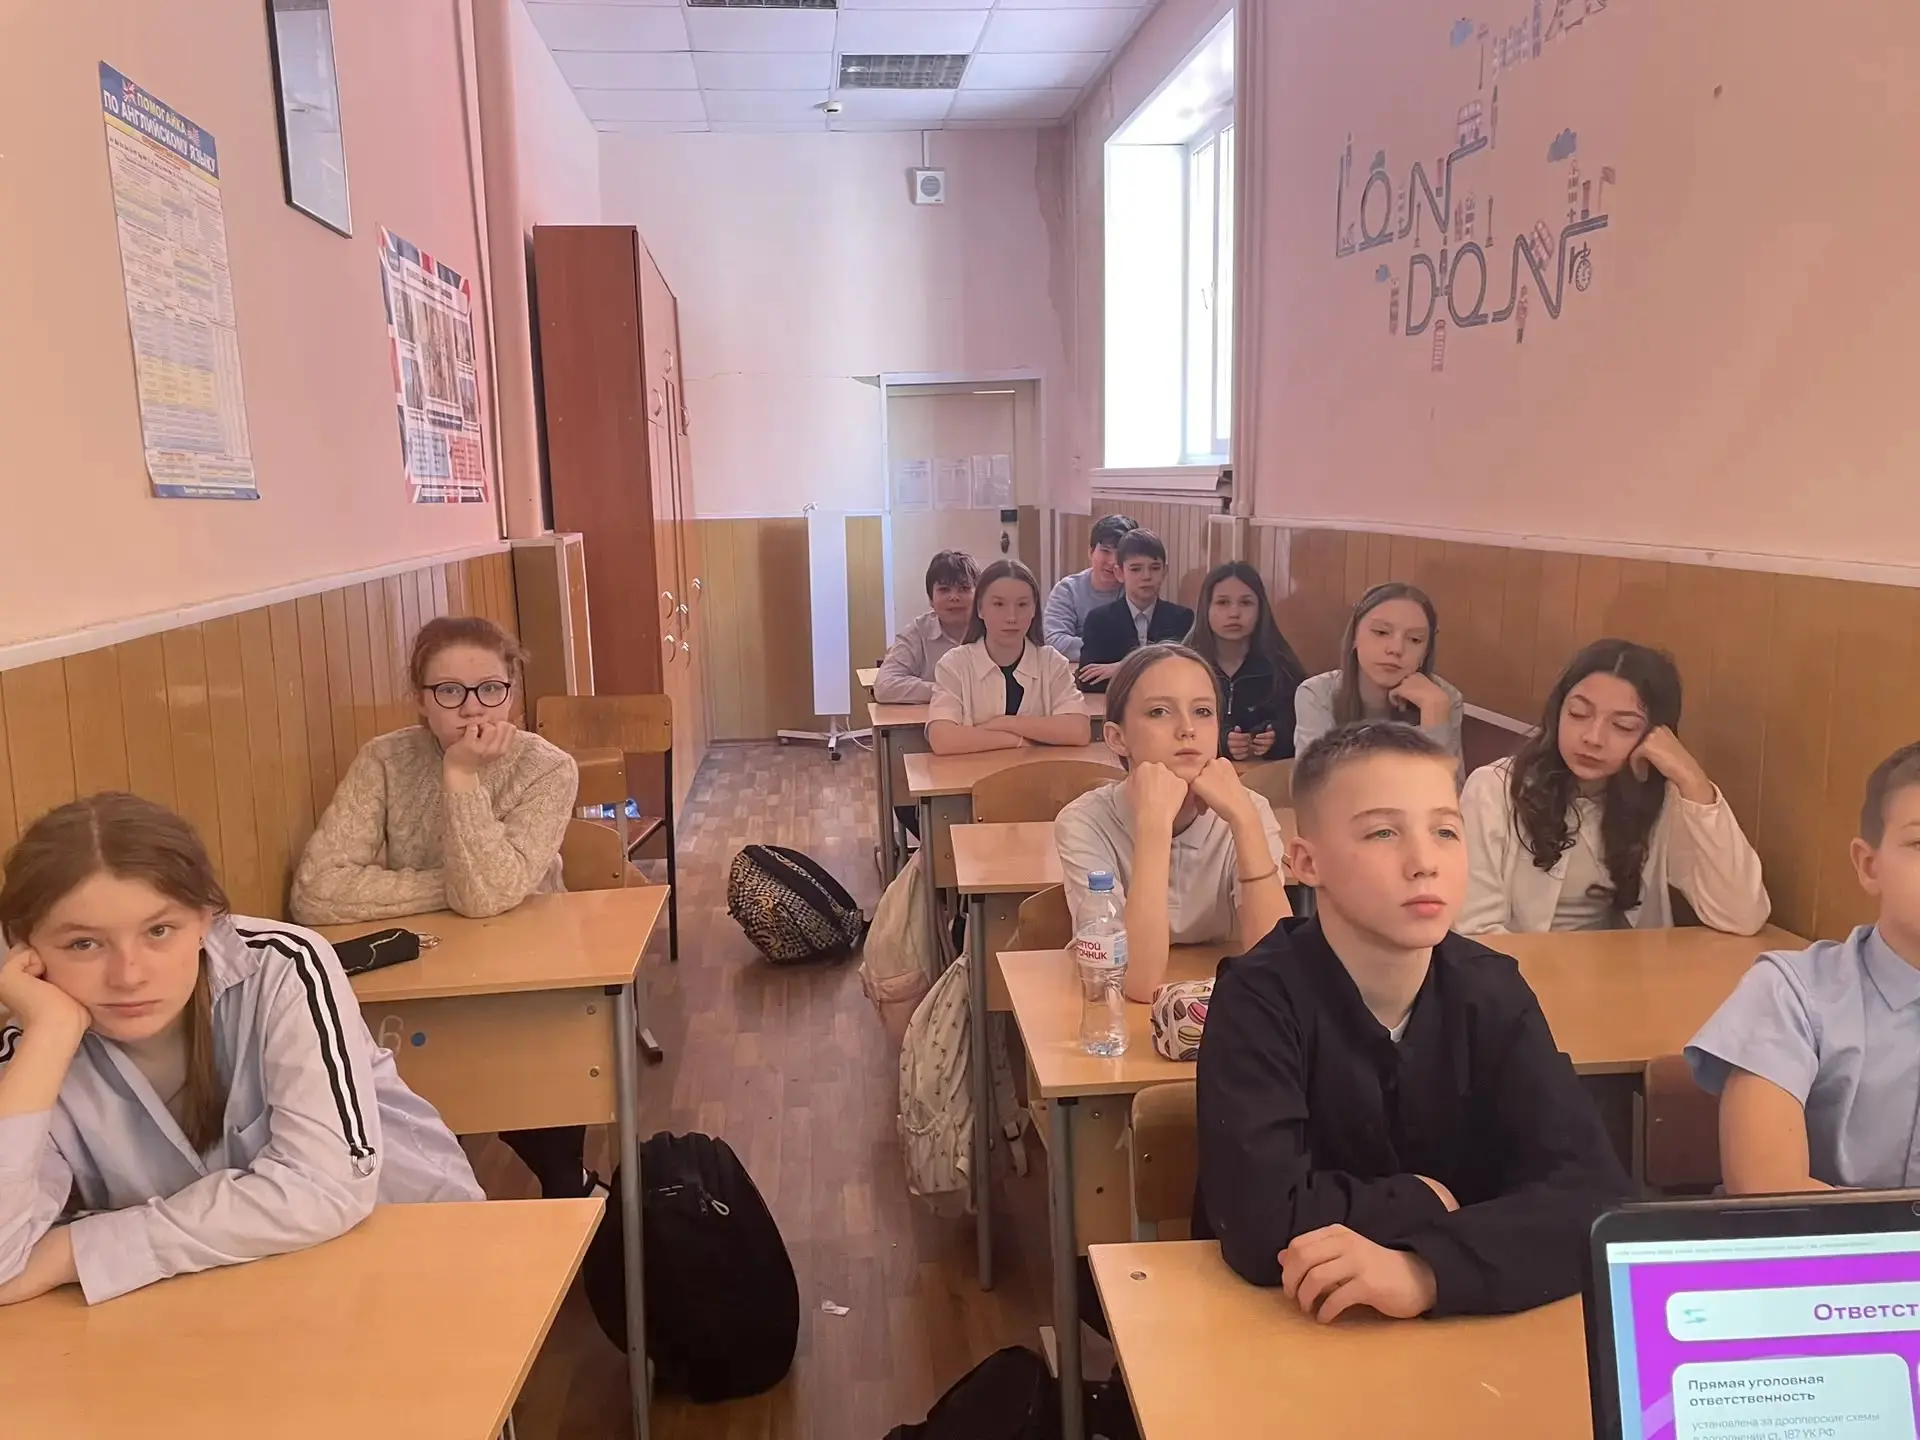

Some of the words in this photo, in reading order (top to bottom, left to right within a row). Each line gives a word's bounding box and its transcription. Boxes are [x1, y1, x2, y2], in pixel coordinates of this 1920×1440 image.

[137, 92, 187, 135] ПОМОГАЙКА
[103, 89, 119, 114] ПО
[121, 101, 188, 156] АНГЛИЙСКОМУ
[189, 144, 216, 173] ЯЗЫКУ
[1814, 1303, 1919, 1321] Ответст
[1688, 1379, 1746, 1392] Прямая
[1748, 1376, 1825, 1390] уголовная
[1689, 1392, 1816, 1407] ответственность
[1692, 1418, 1759, 1432] установлена
[1760, 1418, 1773, 1427] за
[1846, 1412, 1880, 1422] схемы
[1784, 1429, 1800, 1440] 187
[1802, 1428, 1817, 1439] УК
[1818, 1427, 1836, 1437] РФ
